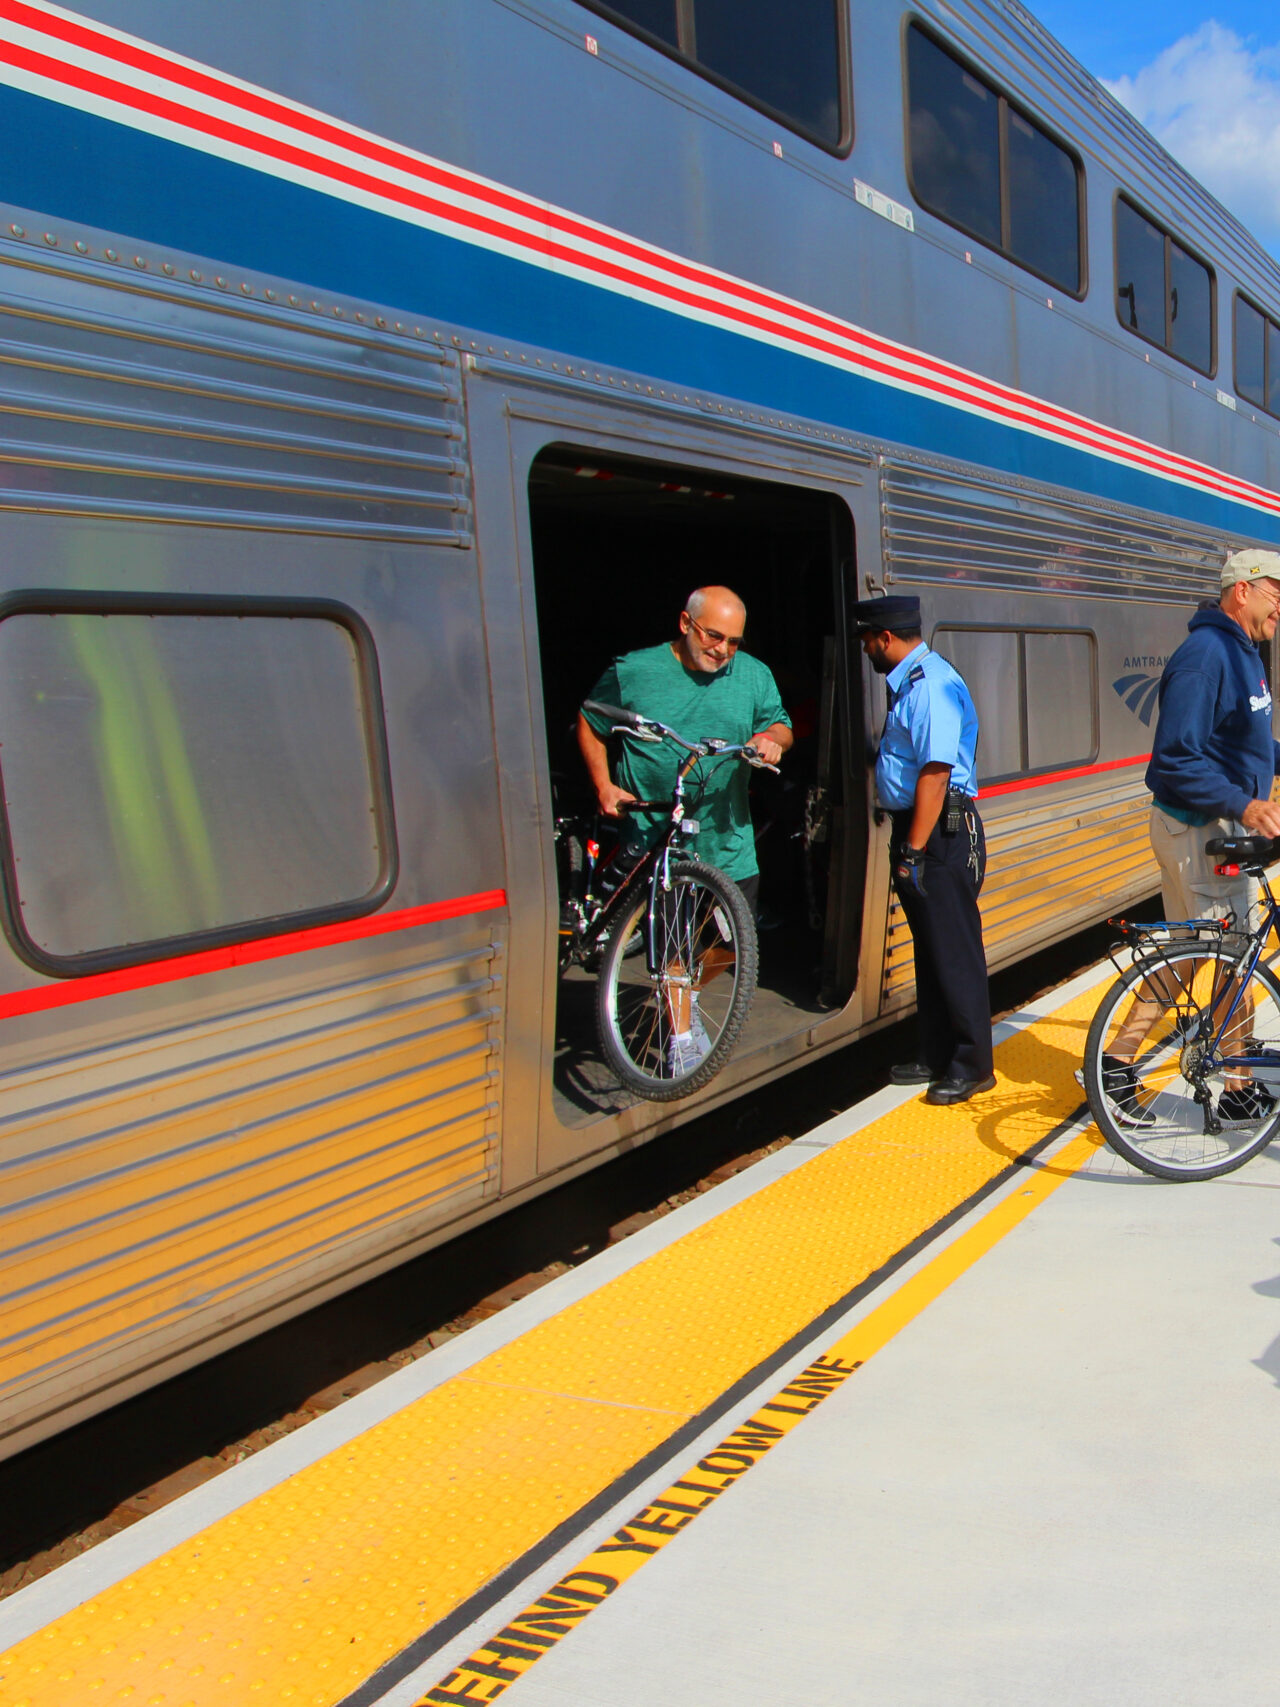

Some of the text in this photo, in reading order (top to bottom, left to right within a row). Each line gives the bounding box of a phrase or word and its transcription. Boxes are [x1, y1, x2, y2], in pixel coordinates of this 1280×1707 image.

[415, 1355, 864, 1707] EHIND YELLOW LINE
